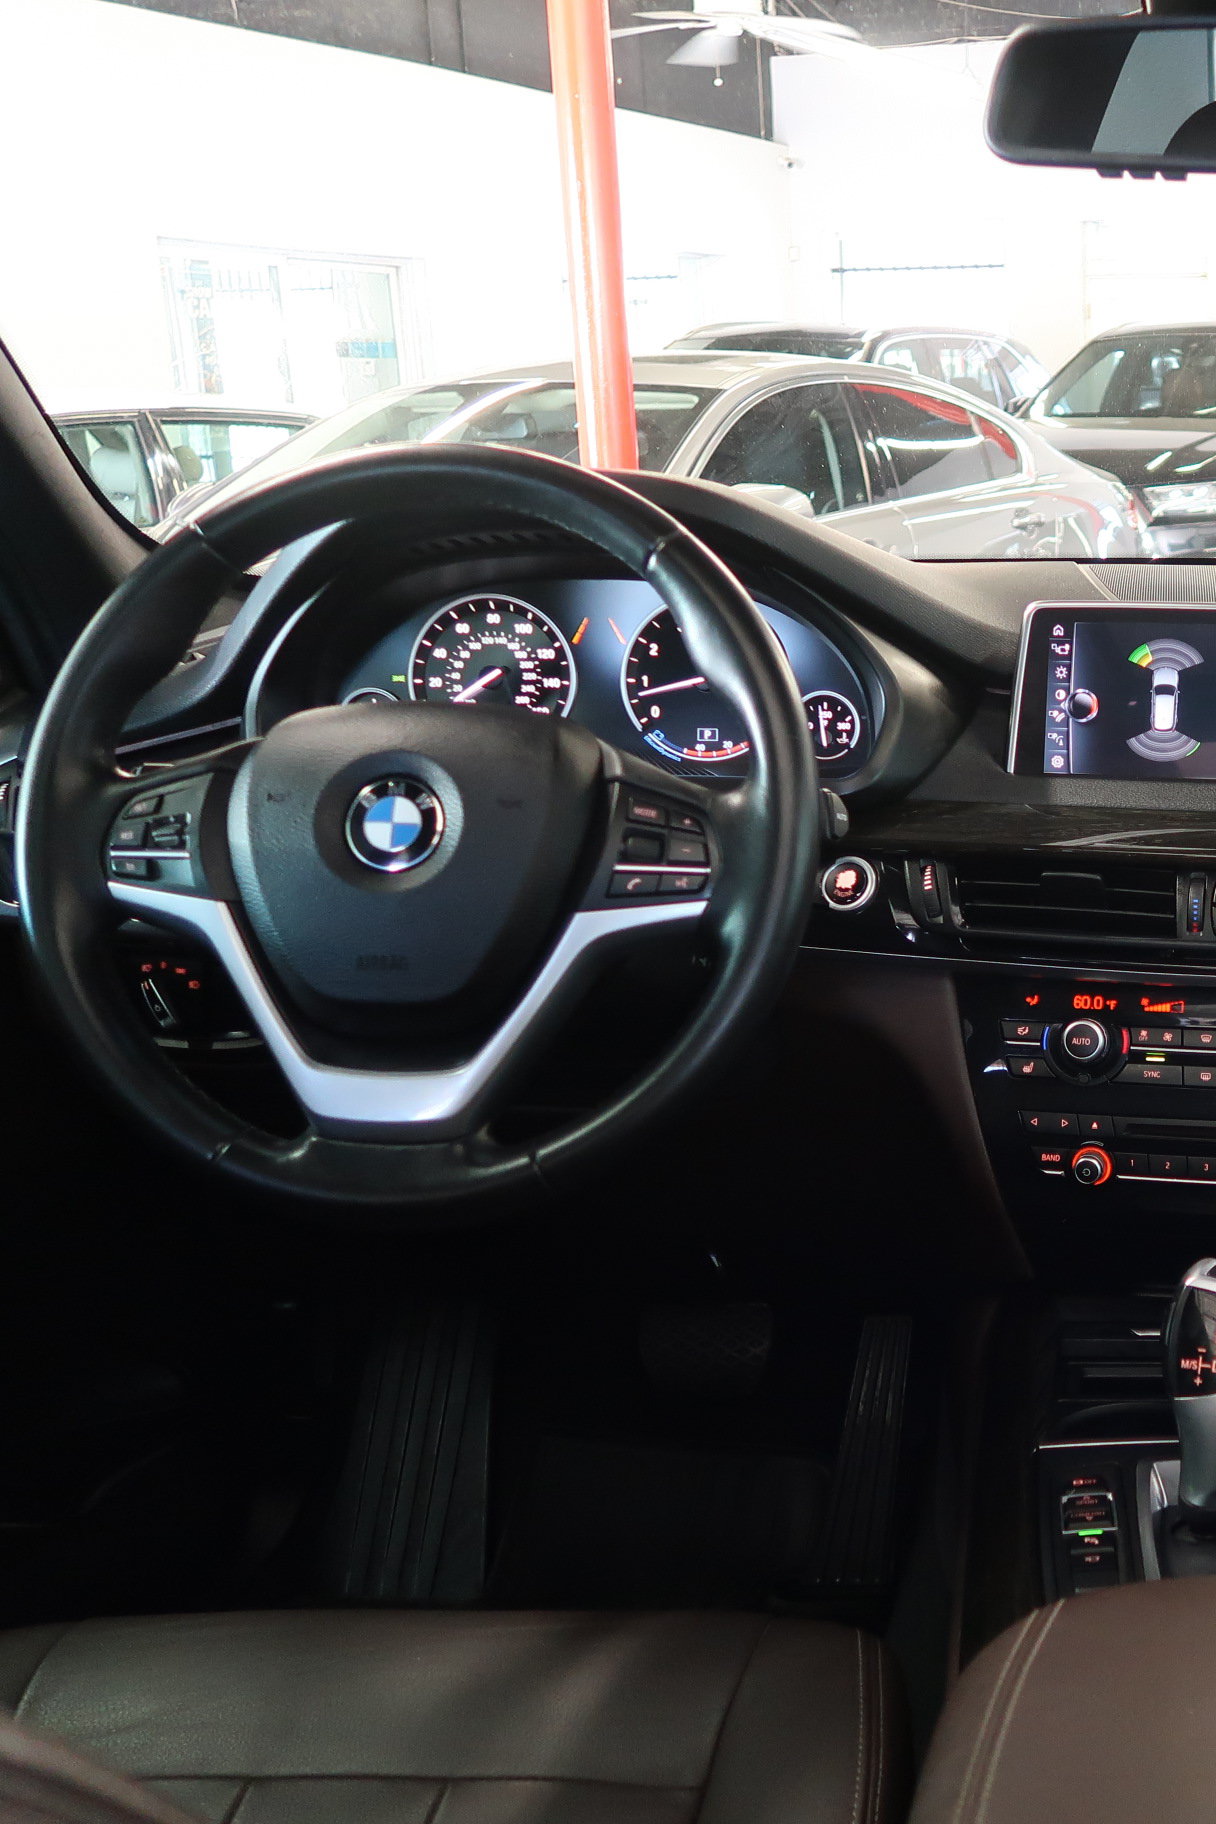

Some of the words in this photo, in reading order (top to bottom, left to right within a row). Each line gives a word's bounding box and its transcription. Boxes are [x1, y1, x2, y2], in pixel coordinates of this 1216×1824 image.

[487, 613, 500, 624] 80
[455, 623, 470, 633] 60
[514, 623, 533, 634] 100
[433, 648, 447, 658] 40
[536, 648, 555, 659] 120
[649, 643, 658, 656] 2
[429, 677, 442, 687] 20
[542, 678, 561, 688] 140
[641, 675, 648, 687] 1
[651, 705, 660, 718] 0
[703, 730, 712, 740] P
[1073, 995, 1104, 1011] 60.0
[1071, 1037, 1091, 1046] AUTO
[1143, 1070, 1161, 1079] SYNC
[1041, 1154, 1061, 1162] BAND
[1130, 1159, 1135, 1167] 1
[1165, 1161, 1171, 1170] 2
[1203, 1163, 1209, 1171] 3
[1181, 1359, 1198, 1370] M/S
